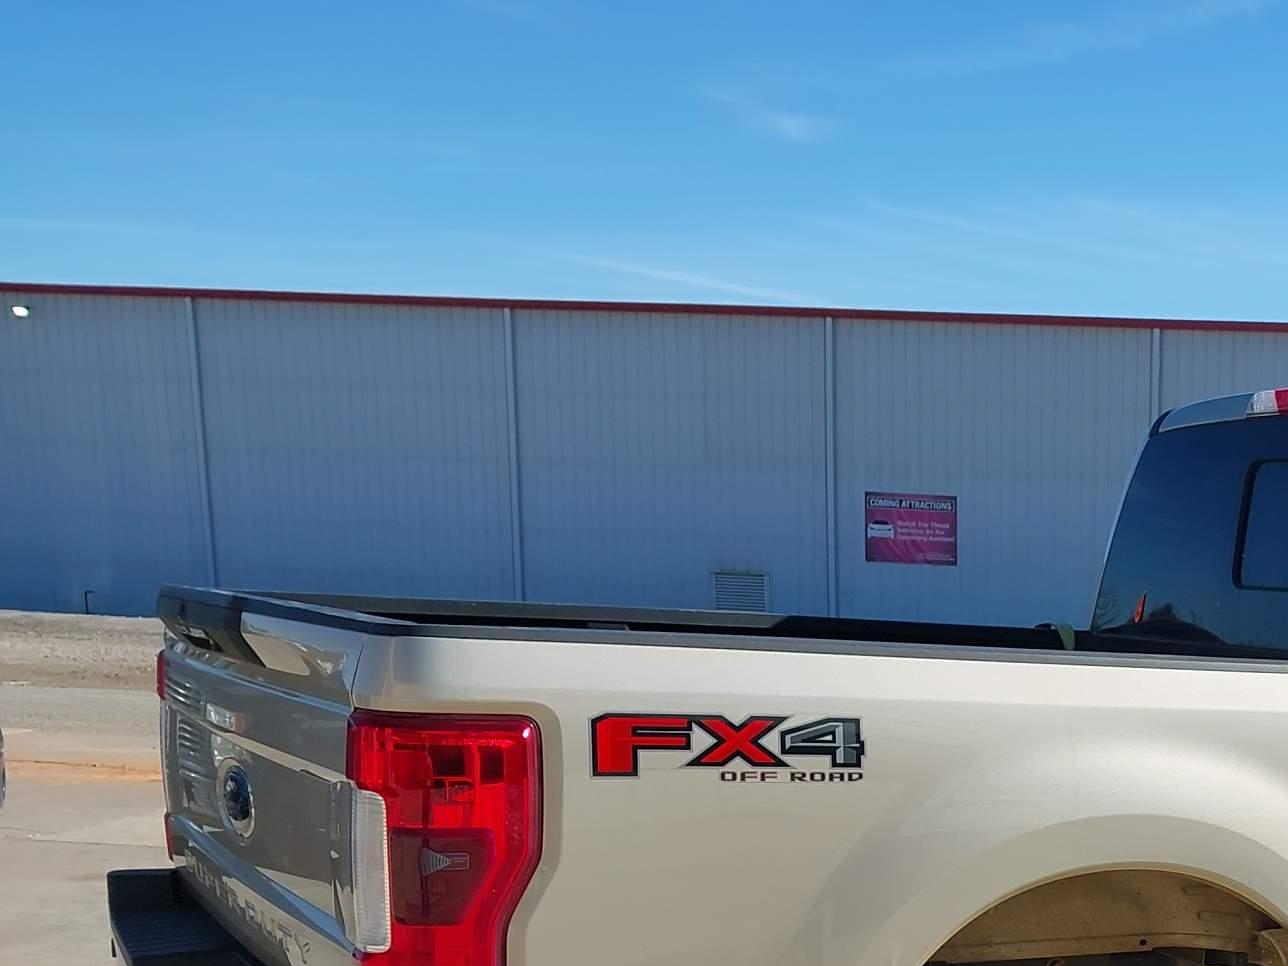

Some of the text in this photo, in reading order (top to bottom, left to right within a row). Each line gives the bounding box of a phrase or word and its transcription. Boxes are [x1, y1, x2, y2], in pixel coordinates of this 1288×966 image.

[870, 498, 952, 511] COMING ATTRACTIONS
[591, 712, 865, 777] FX4
[720, 770, 863, 782] OFF ROAD
